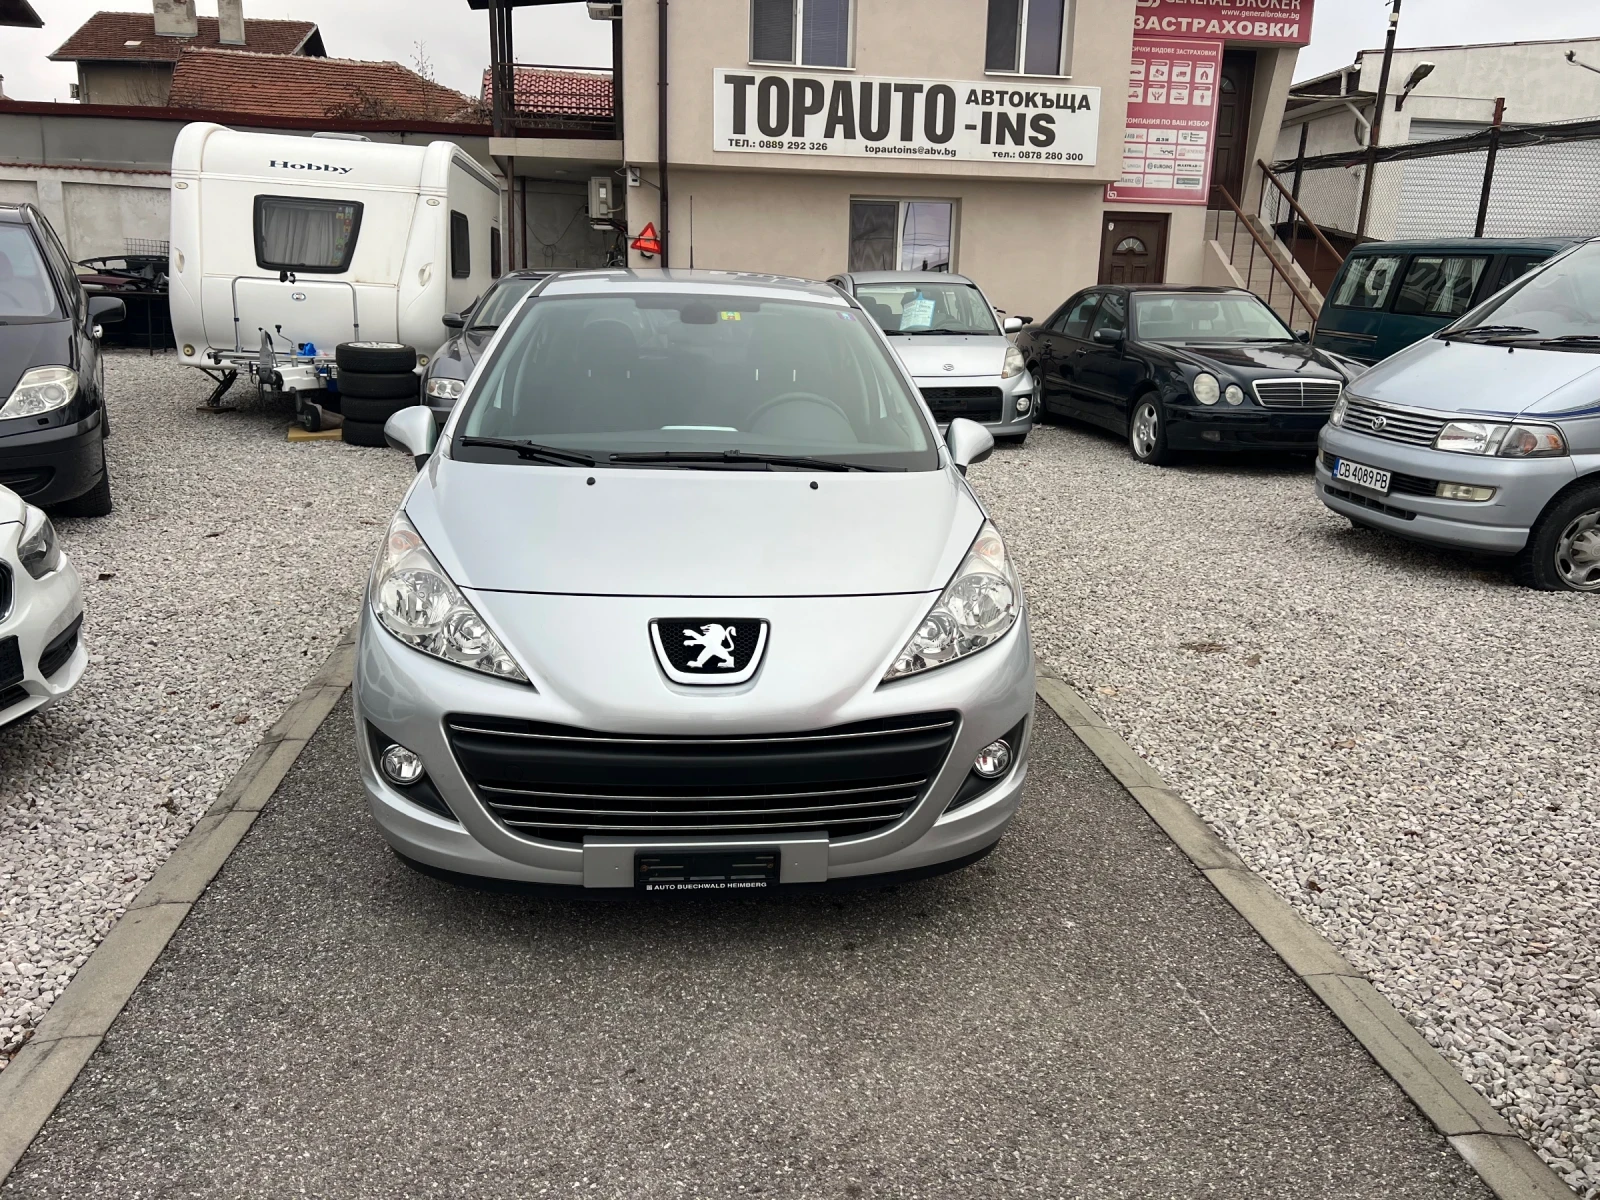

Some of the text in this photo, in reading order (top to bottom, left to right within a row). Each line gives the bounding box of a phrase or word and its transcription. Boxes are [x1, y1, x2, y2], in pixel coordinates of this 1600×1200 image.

[1221, 9, 1300, 20] www.generalbroker.bg
[1133, 14, 1299, 38] ЗАСТРАХОВКИ
[1151, 46, 1175, 55] ВИДОВЕ
[1176, 48, 1217, 56] ЗАСТРАХОВКИ
[965, 89, 1092, 113] АВТОКЪЩА
[724, 74, 957, 144] TOPAUTO
[1161, 118, 1171, 126] ПО
[1188, 119, 1210, 127] ИЗБОР
[965, 111, 1057, 148] -INS
[728, 138, 828, 151] ТЕЛ.: 0889 292 326
[864, 144, 957, 157] topautoins@abv.bg
[992, 150, 1084, 161] тел.: 0878 280 300
[268, 160, 354, 174] Hobby
[1352, 465, 1374, 484] 4089
